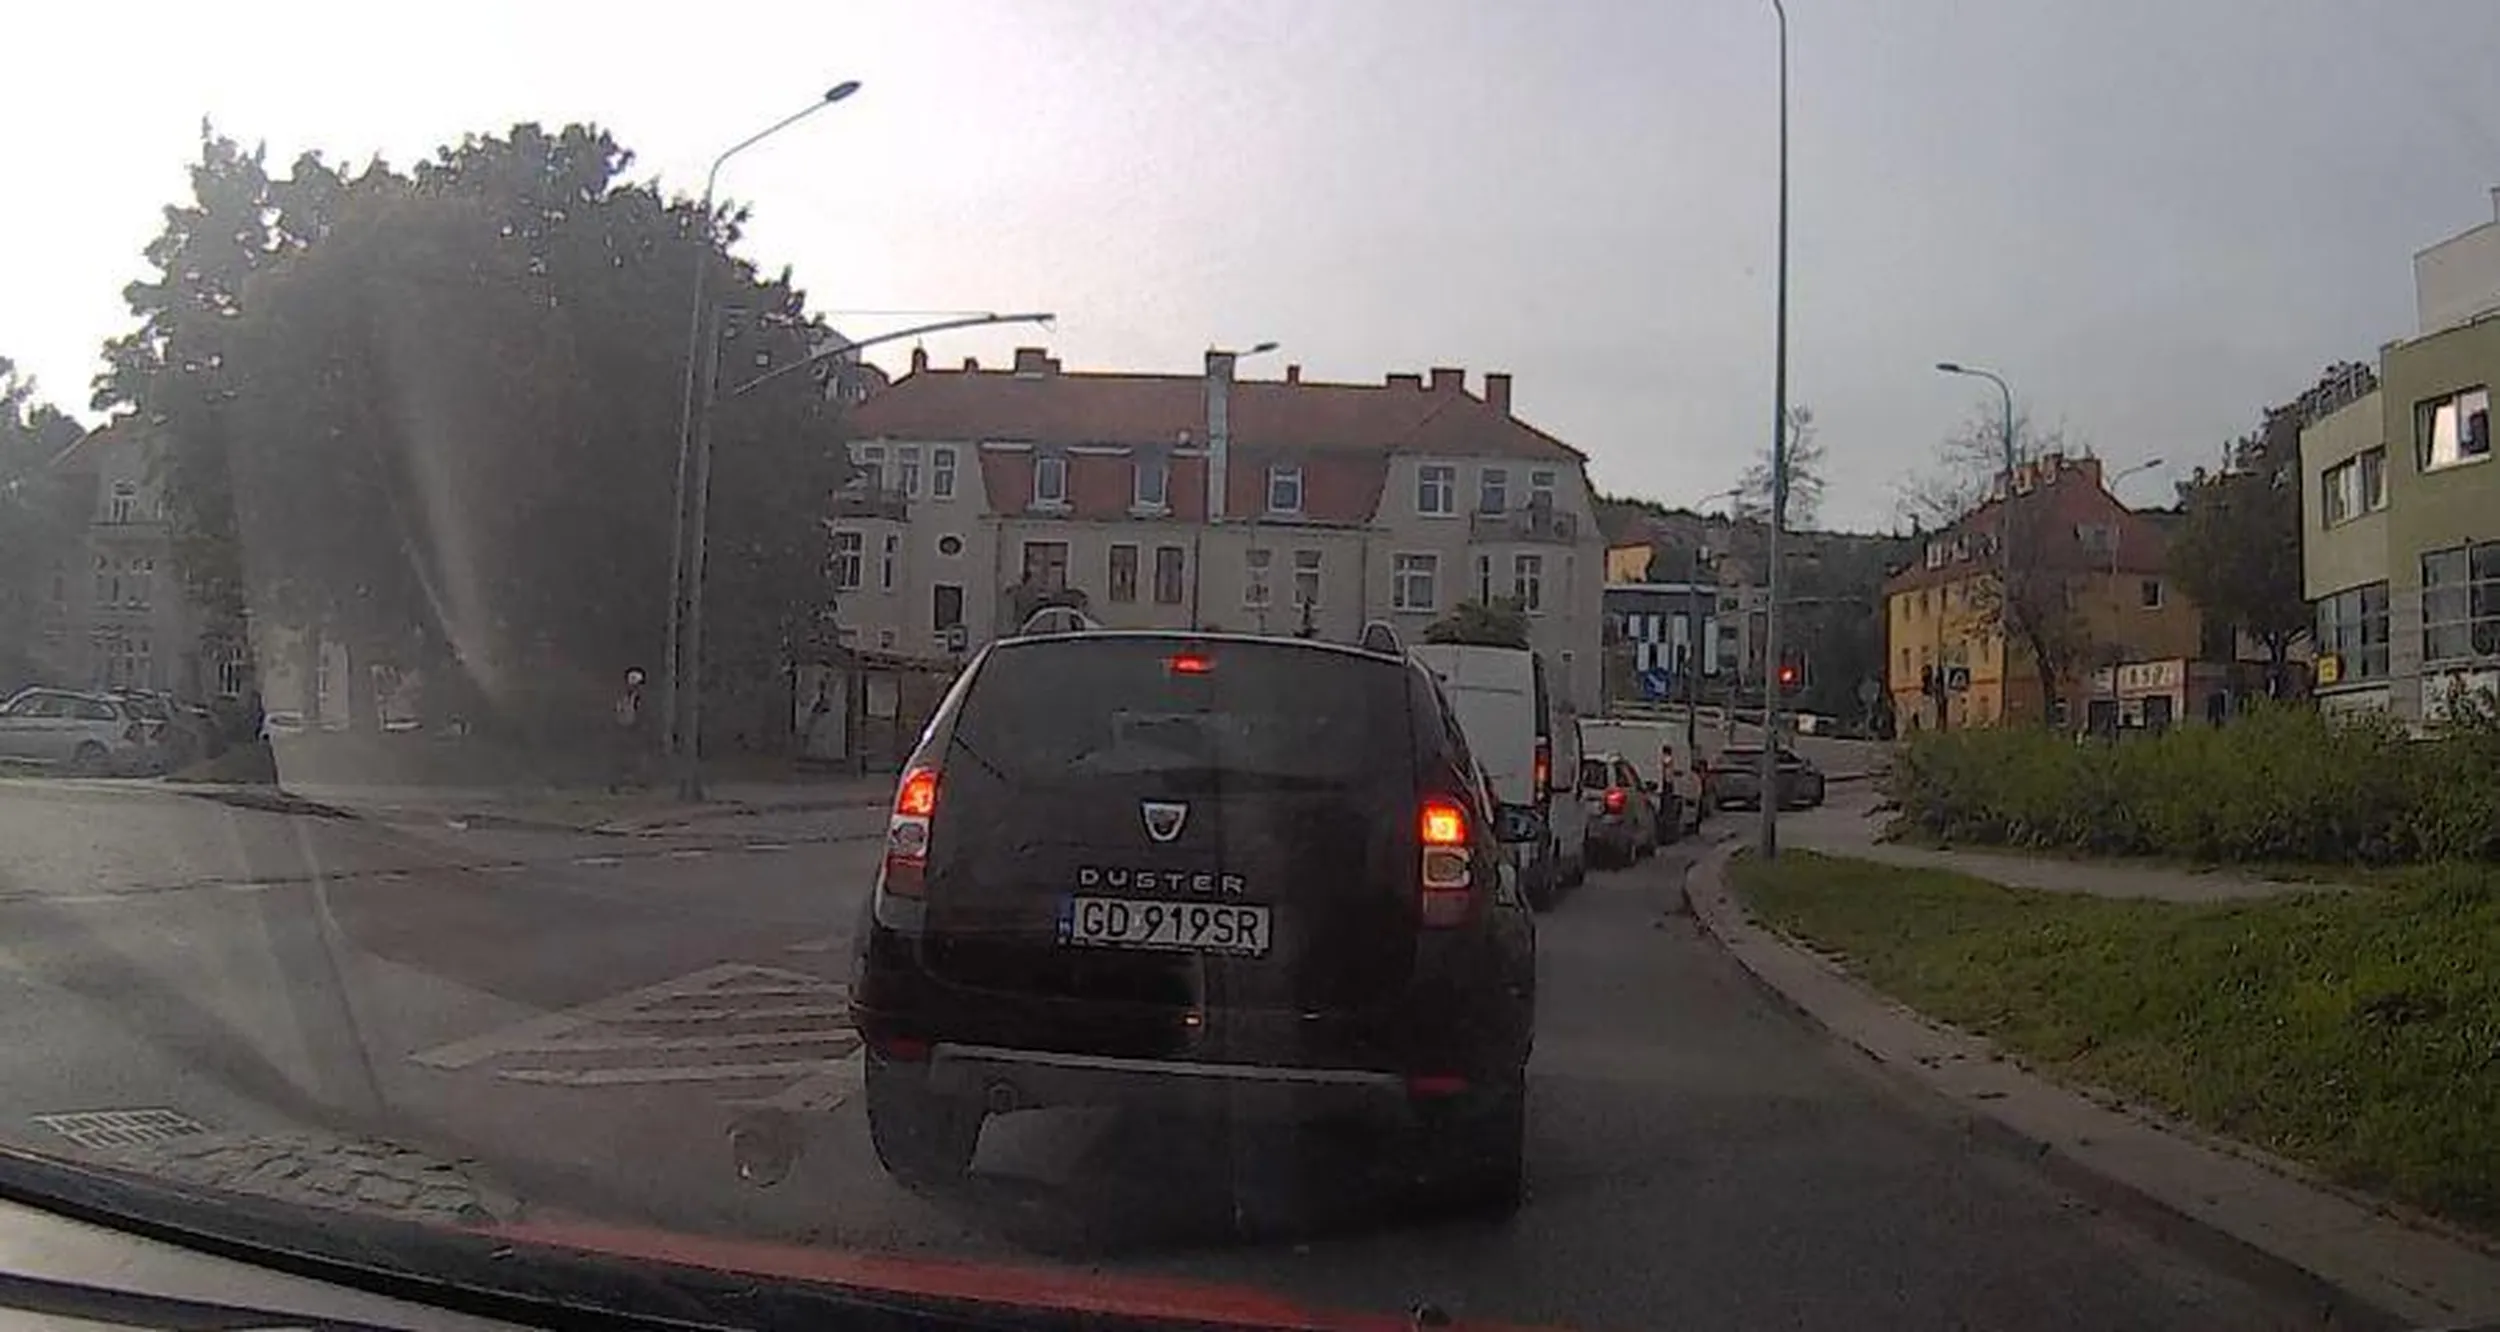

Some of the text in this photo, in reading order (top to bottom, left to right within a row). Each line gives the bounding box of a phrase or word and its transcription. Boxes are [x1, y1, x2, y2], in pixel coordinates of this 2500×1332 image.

[1080, 868, 1245, 894] DUSTER
[1083, 902, 1129, 937] GD
[1144, 905, 1259, 946] 919SR
